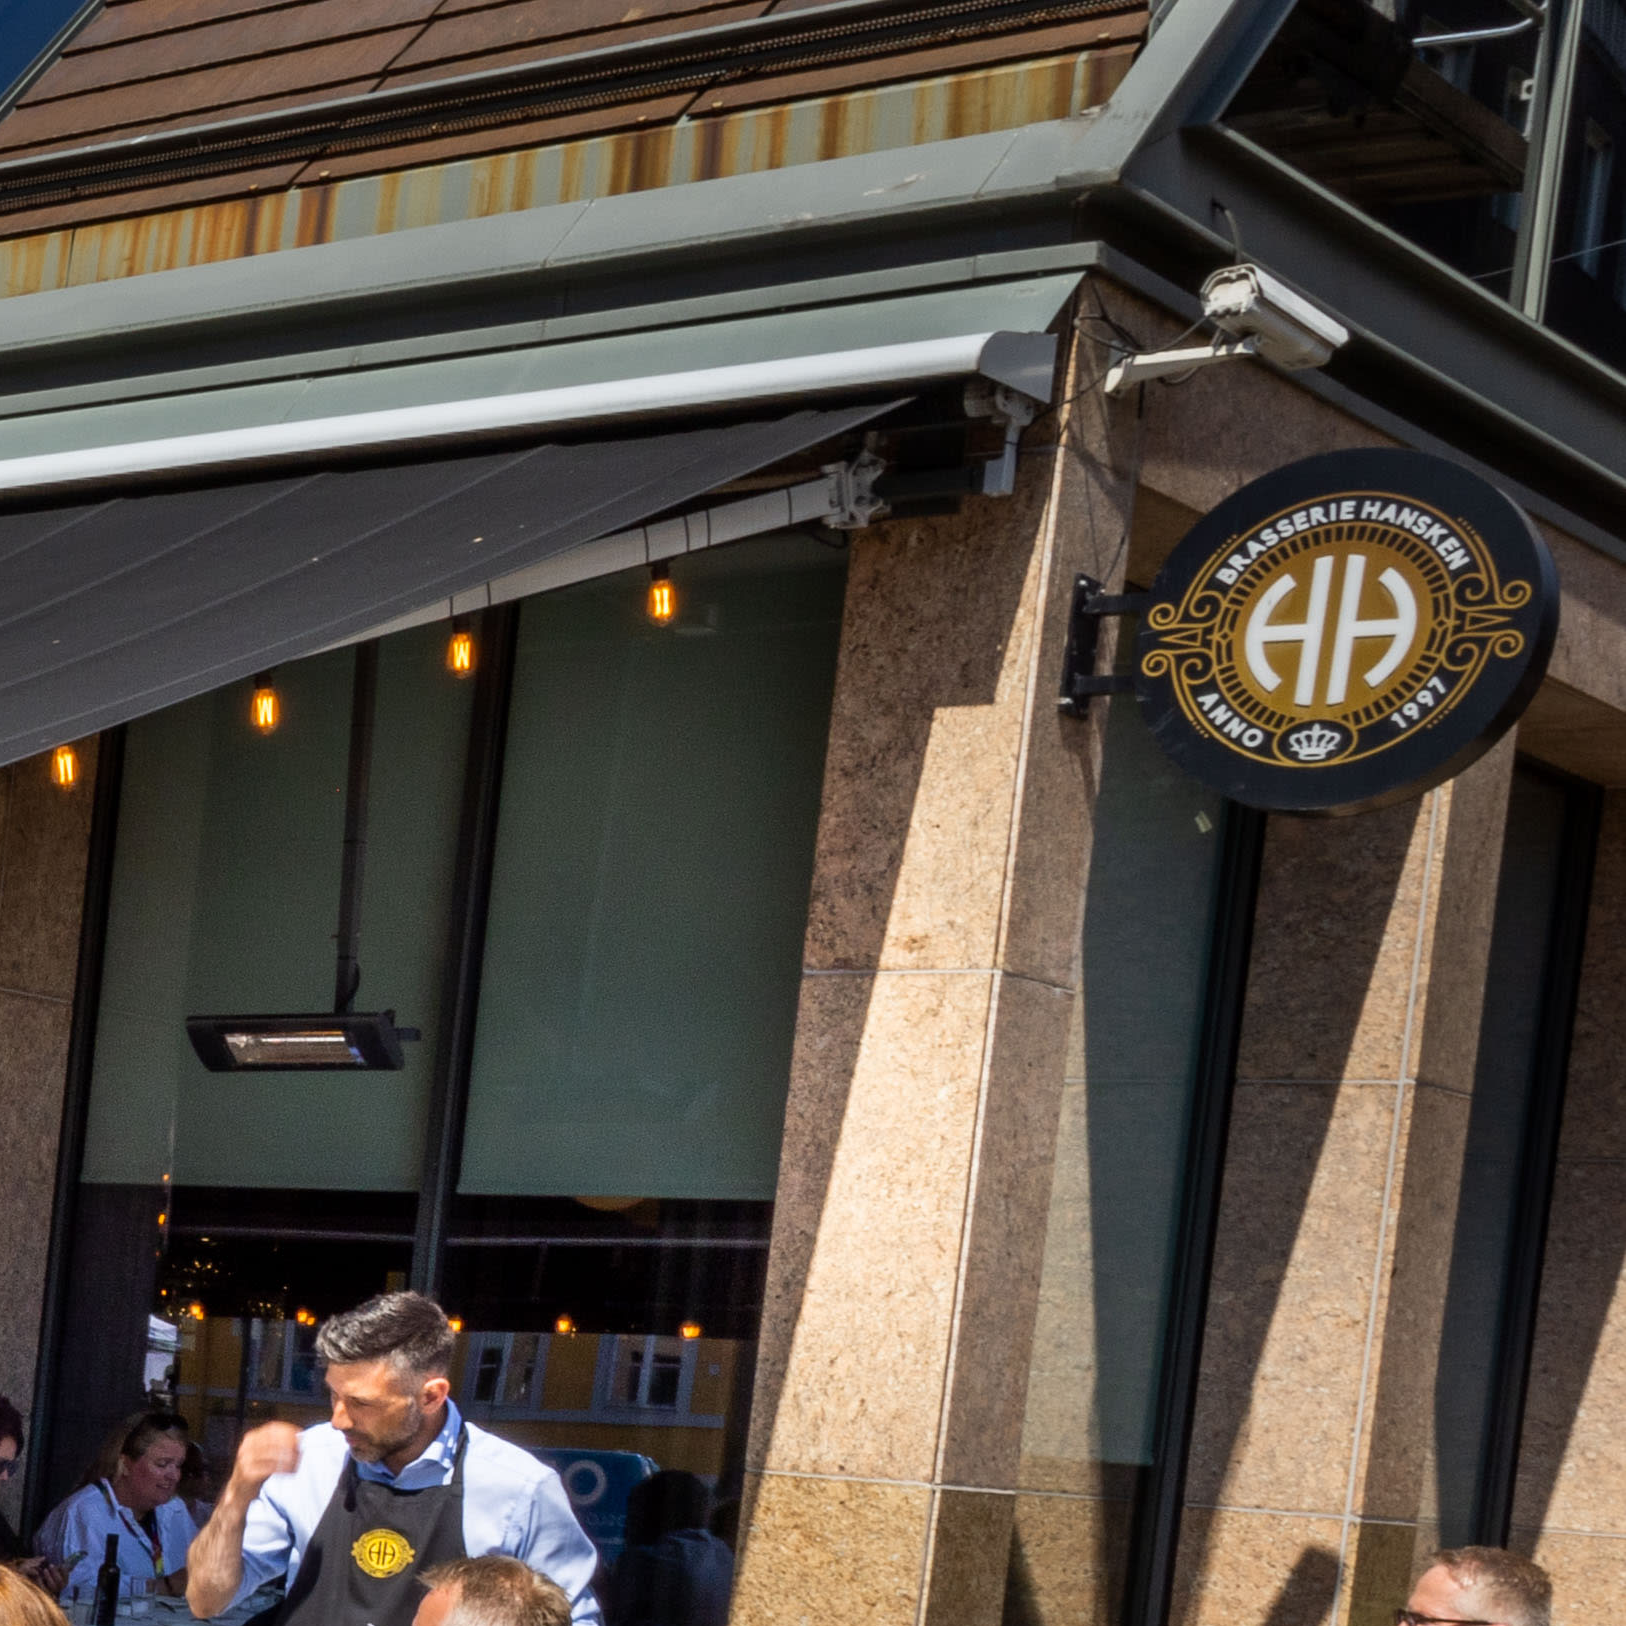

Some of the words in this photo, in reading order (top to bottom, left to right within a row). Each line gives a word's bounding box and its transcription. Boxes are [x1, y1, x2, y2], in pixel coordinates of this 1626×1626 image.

[1216, 500, 1356, 586] BRASSERIE
[1360, 500, 1470, 571] HANSKEN
[1197, 693, 1264, 748] ANNO
[1390, 676, 1448, 730] 1997
